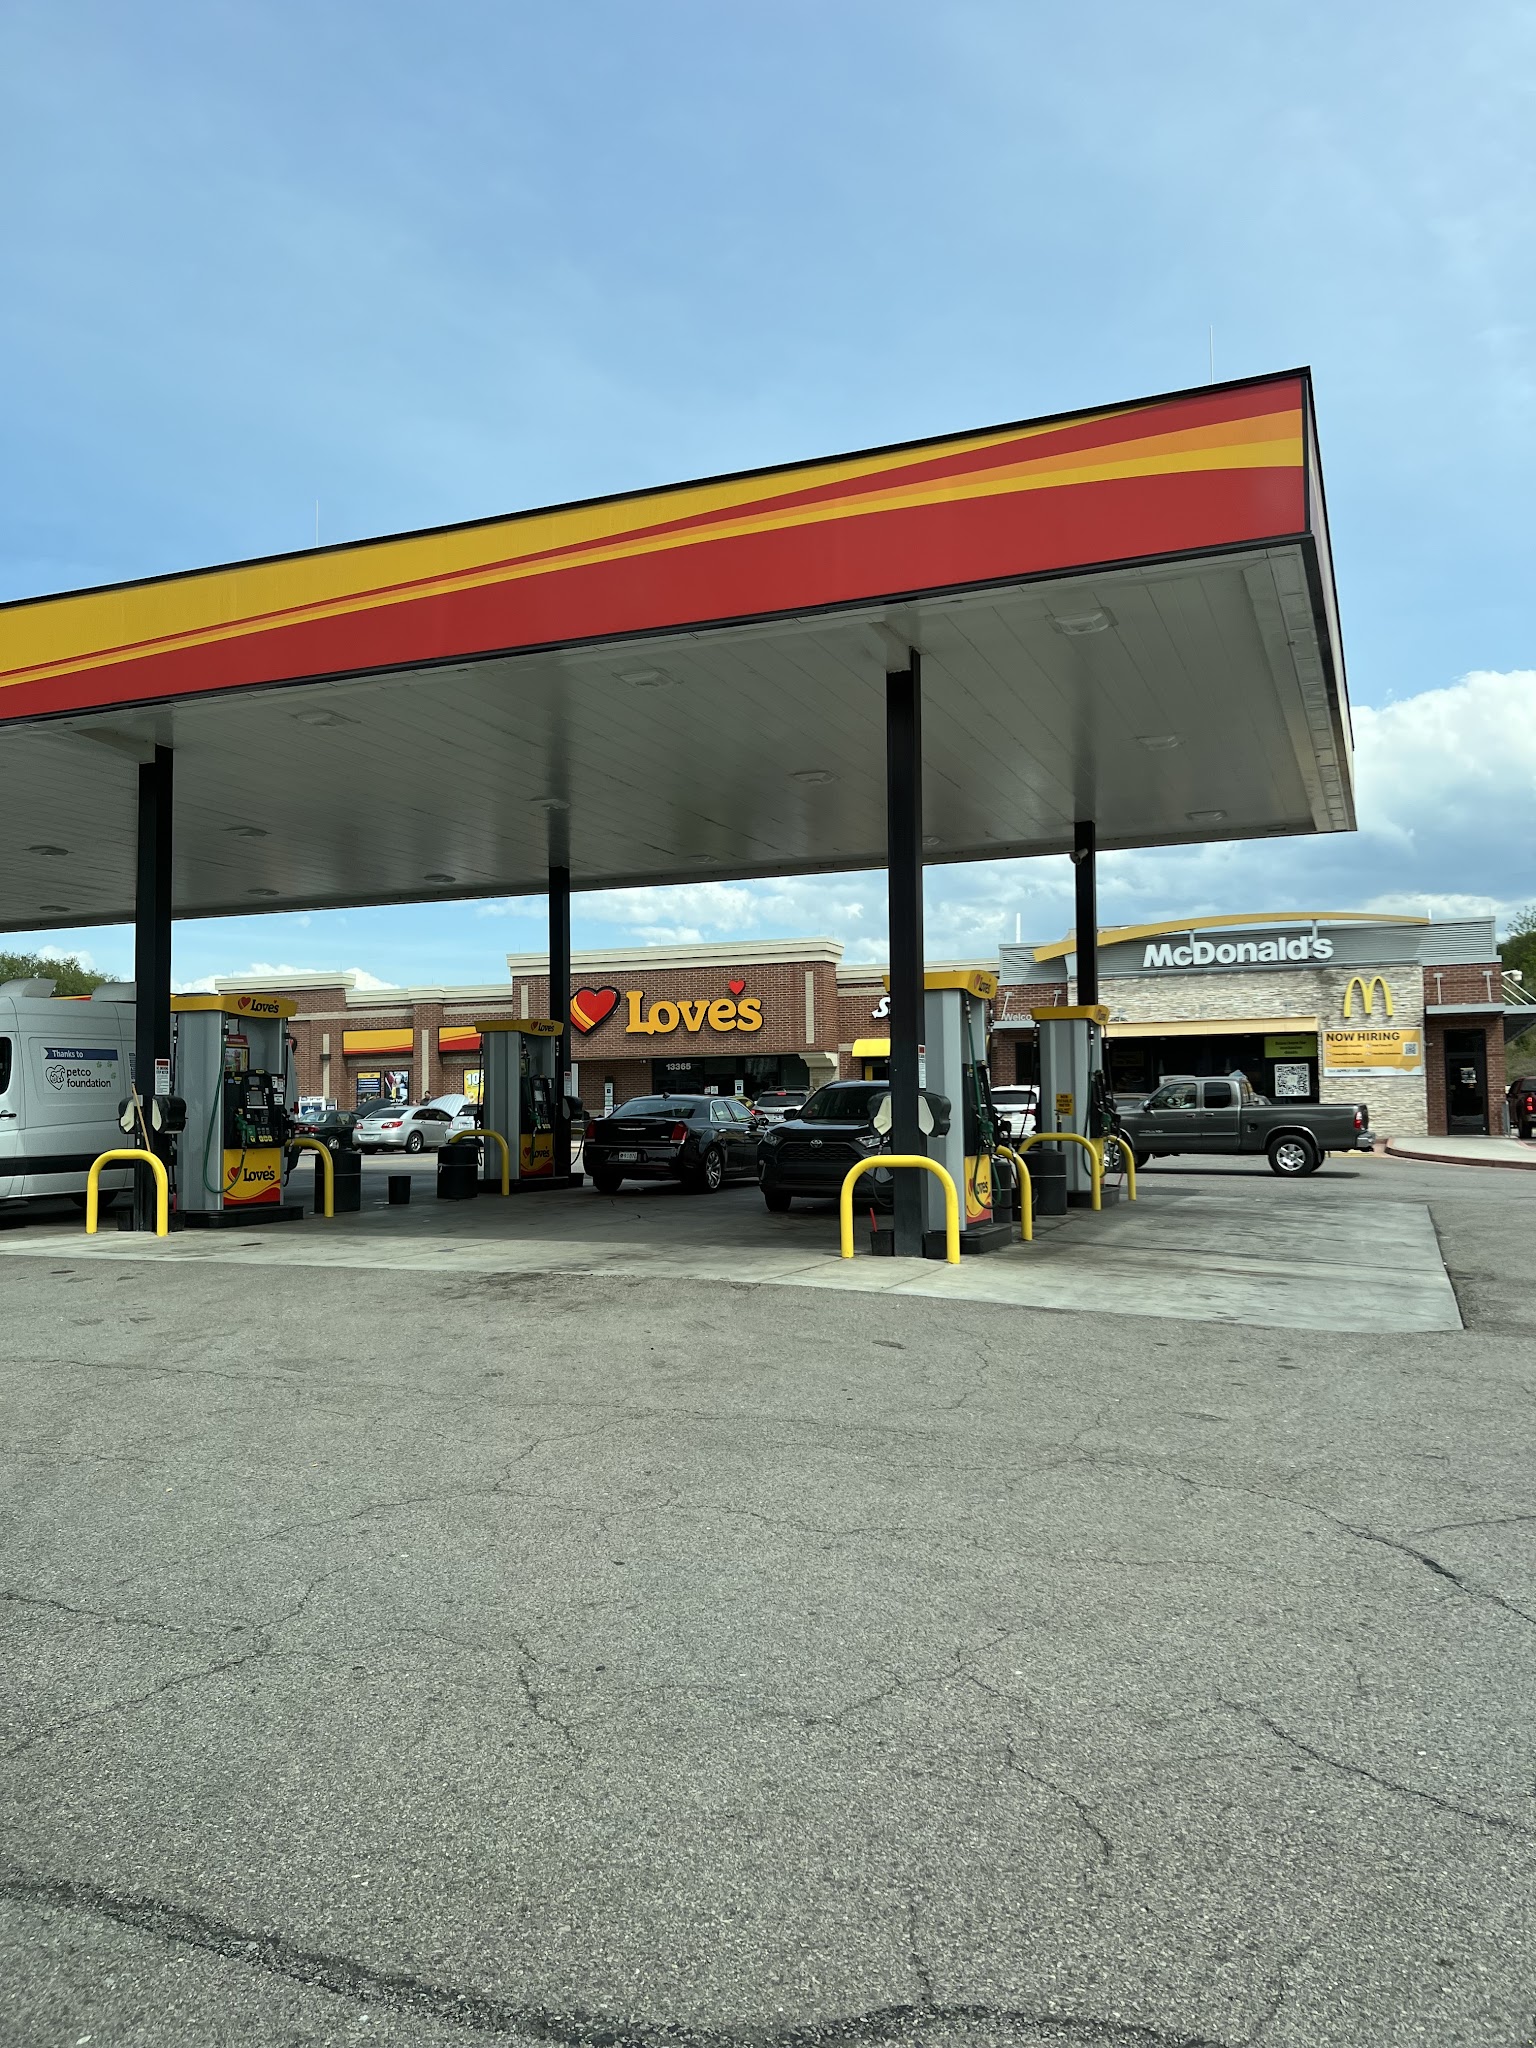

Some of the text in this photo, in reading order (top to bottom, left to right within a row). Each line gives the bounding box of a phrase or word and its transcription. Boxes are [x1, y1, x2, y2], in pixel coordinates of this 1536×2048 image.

[1143, 935, 1334, 968] McDonald's
[1326, 1032, 1400, 1042] NOW HIRING
[52, 1049, 75, 1058] Thanks
[666, 1063, 692, 1071] 13365
[66, 1068, 91, 1078] petco
[66, 1078, 111, 1088] foundation
